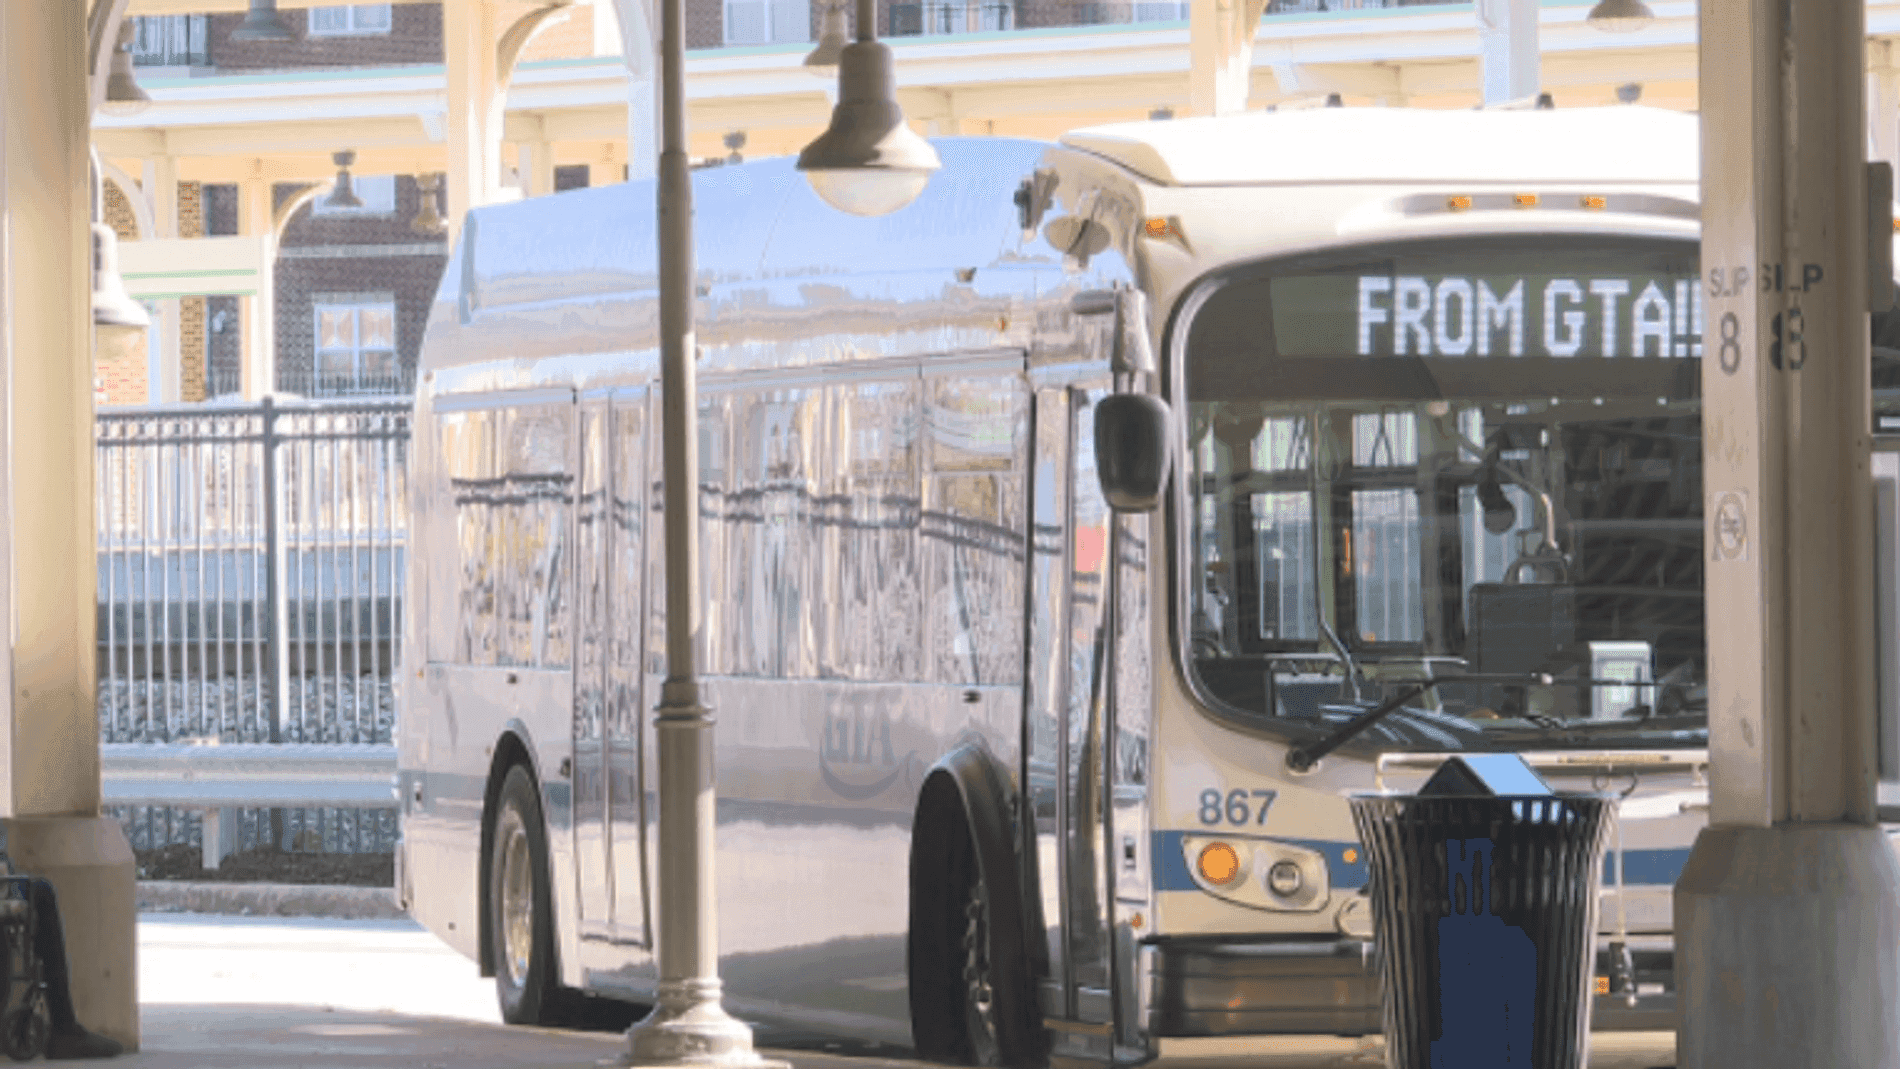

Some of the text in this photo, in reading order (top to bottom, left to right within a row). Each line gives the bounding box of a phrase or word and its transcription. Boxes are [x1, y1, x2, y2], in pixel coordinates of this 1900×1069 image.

[1357, 276, 1524, 356] FROM
[1720, 311, 1741, 376] 8
[1770, 307, 1806, 372] 8
[1200, 787, 1277, 827] 867
